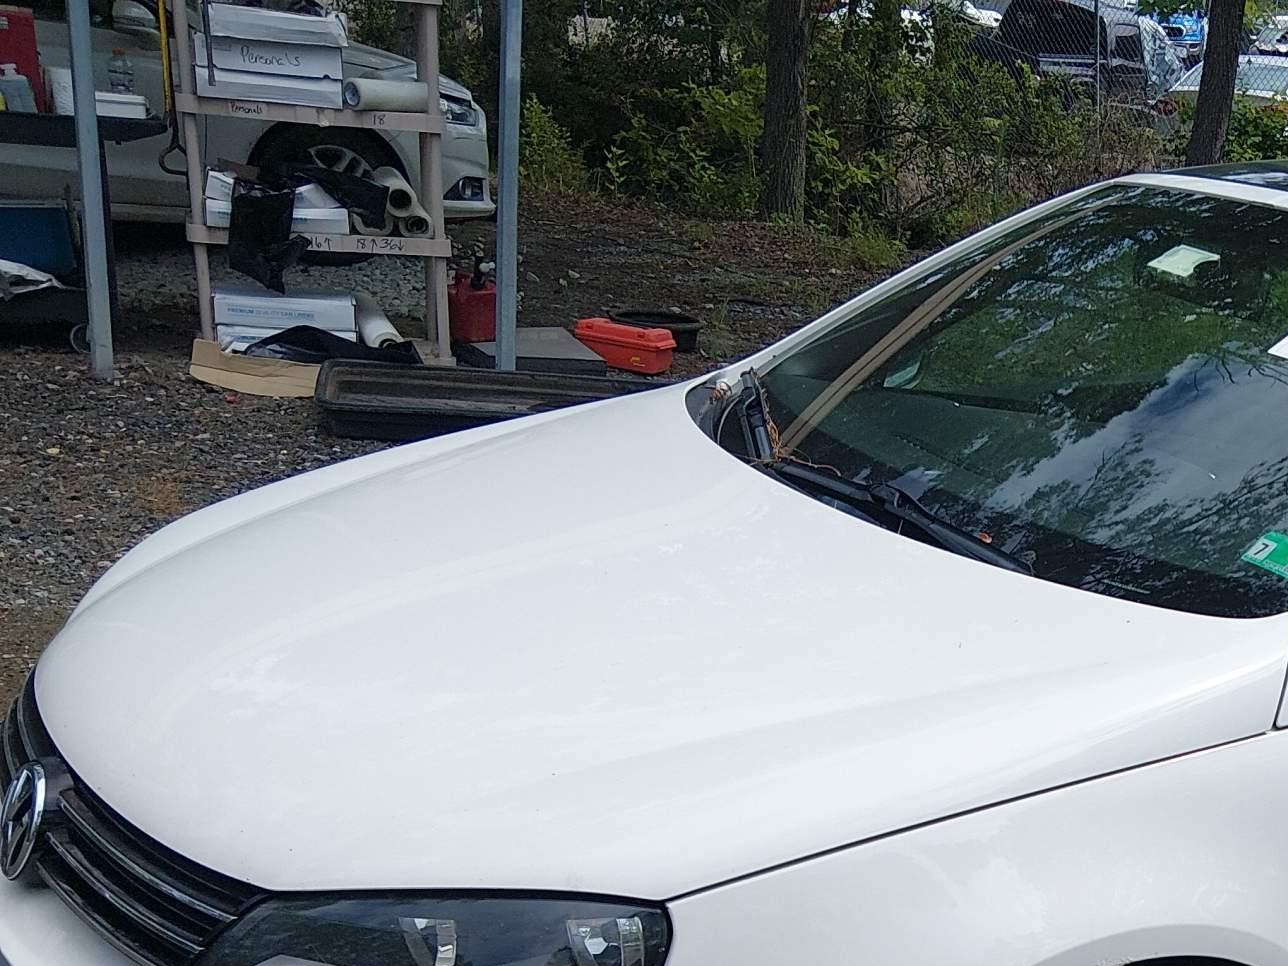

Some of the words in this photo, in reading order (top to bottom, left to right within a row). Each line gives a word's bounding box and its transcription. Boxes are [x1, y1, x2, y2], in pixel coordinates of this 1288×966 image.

[240, 44, 301, 67] Personals
[373, 113, 386, 126] 18
[1253, 542, 1270, 556] 7
